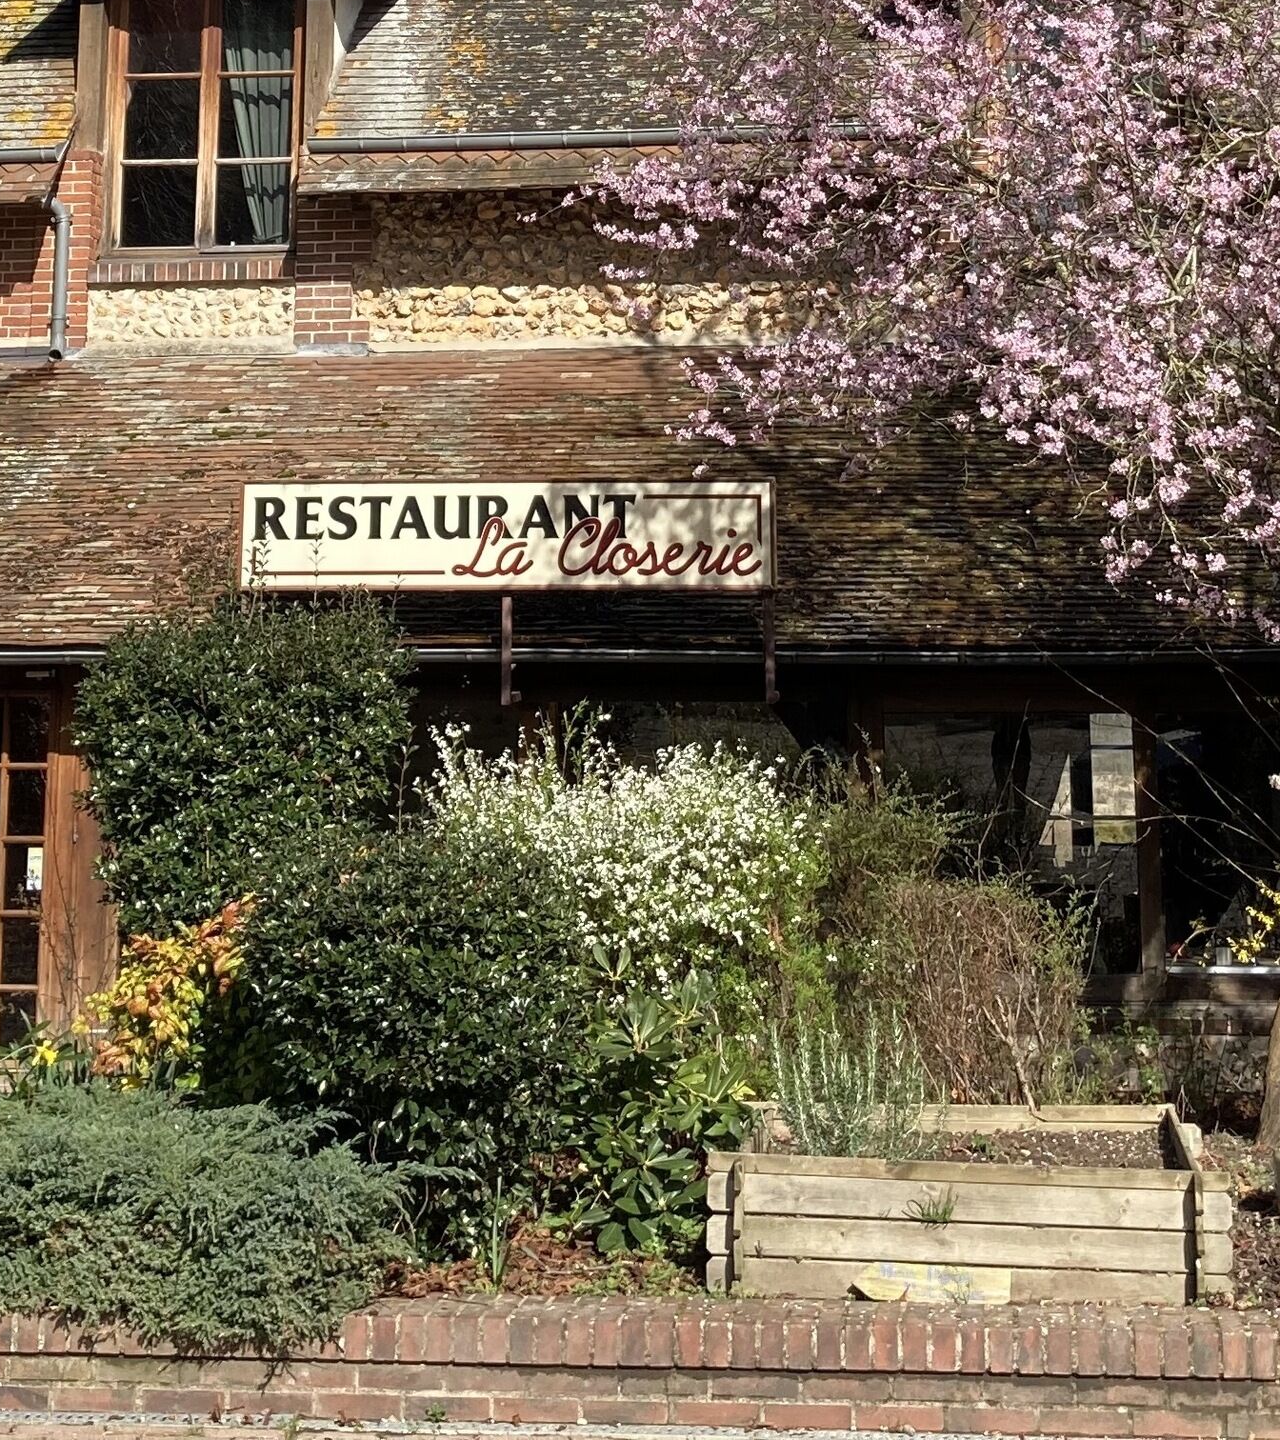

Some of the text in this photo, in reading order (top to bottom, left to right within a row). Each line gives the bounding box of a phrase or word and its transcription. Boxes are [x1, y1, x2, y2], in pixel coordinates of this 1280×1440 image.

[253, 494, 637, 541] RESTAURANT
[451, 516, 763, 578] La Closerie
